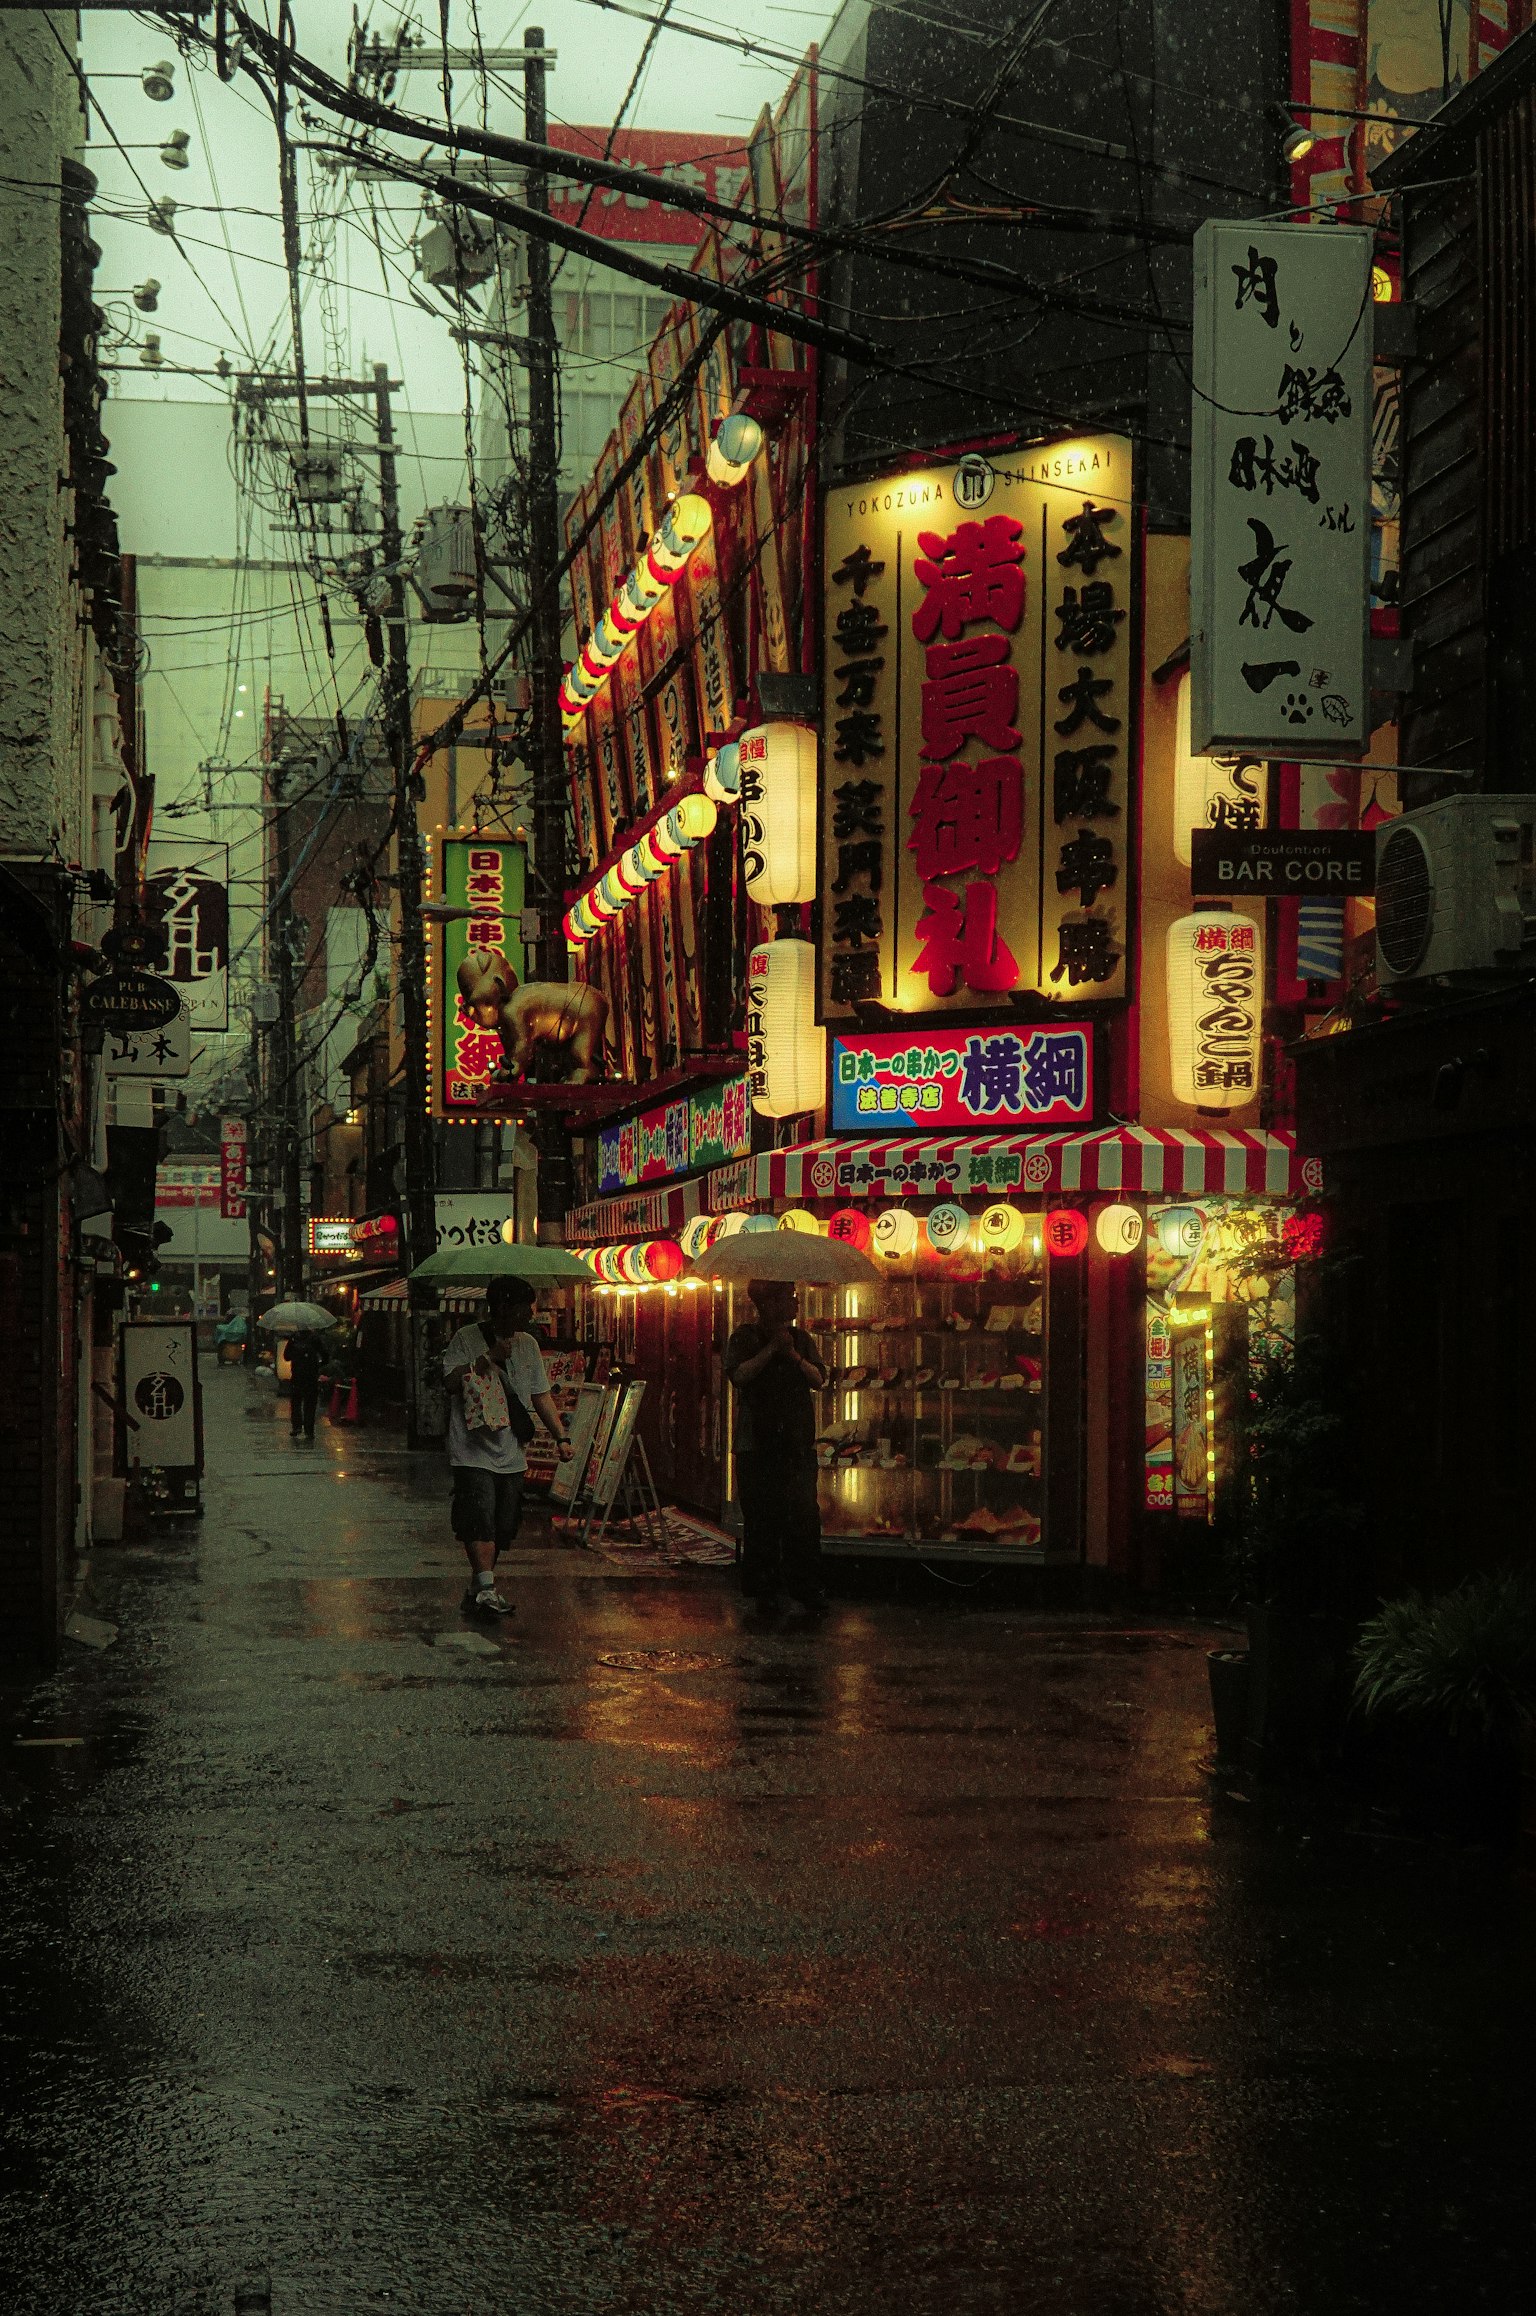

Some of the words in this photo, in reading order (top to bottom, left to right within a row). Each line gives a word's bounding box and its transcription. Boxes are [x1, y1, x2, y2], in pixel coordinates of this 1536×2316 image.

[847, 484, 943, 517] YOKOZUNA
[1004, 451, 1112, 486] SHINSEKAI
[906, 515, 1026, 997] 満員御礼
[1218, 861, 1275, 881] BAR
[1285, 859, 1363, 881] CORE
[1196, 926, 1255, 951] 横綱
[118, 980, 147, 992] PUB
[88, 996, 174, 1013] CALEBASSE
[1196, 952, 1256, 1088] ちゃんこ鍋
[111, 1034, 179, 1065] 山本
[841, 1048, 959, 1081] 日本一の串かつ
[961, 1035, 1084, 1112] 横綱
[858, 1086, 941, 1111] 法善寺店
[838, 1160, 962, 1185] 日本一の串かつ
[968, 1154, 1022, 1185] 横綱
[1052, 1222, 1073, 1245] 串
